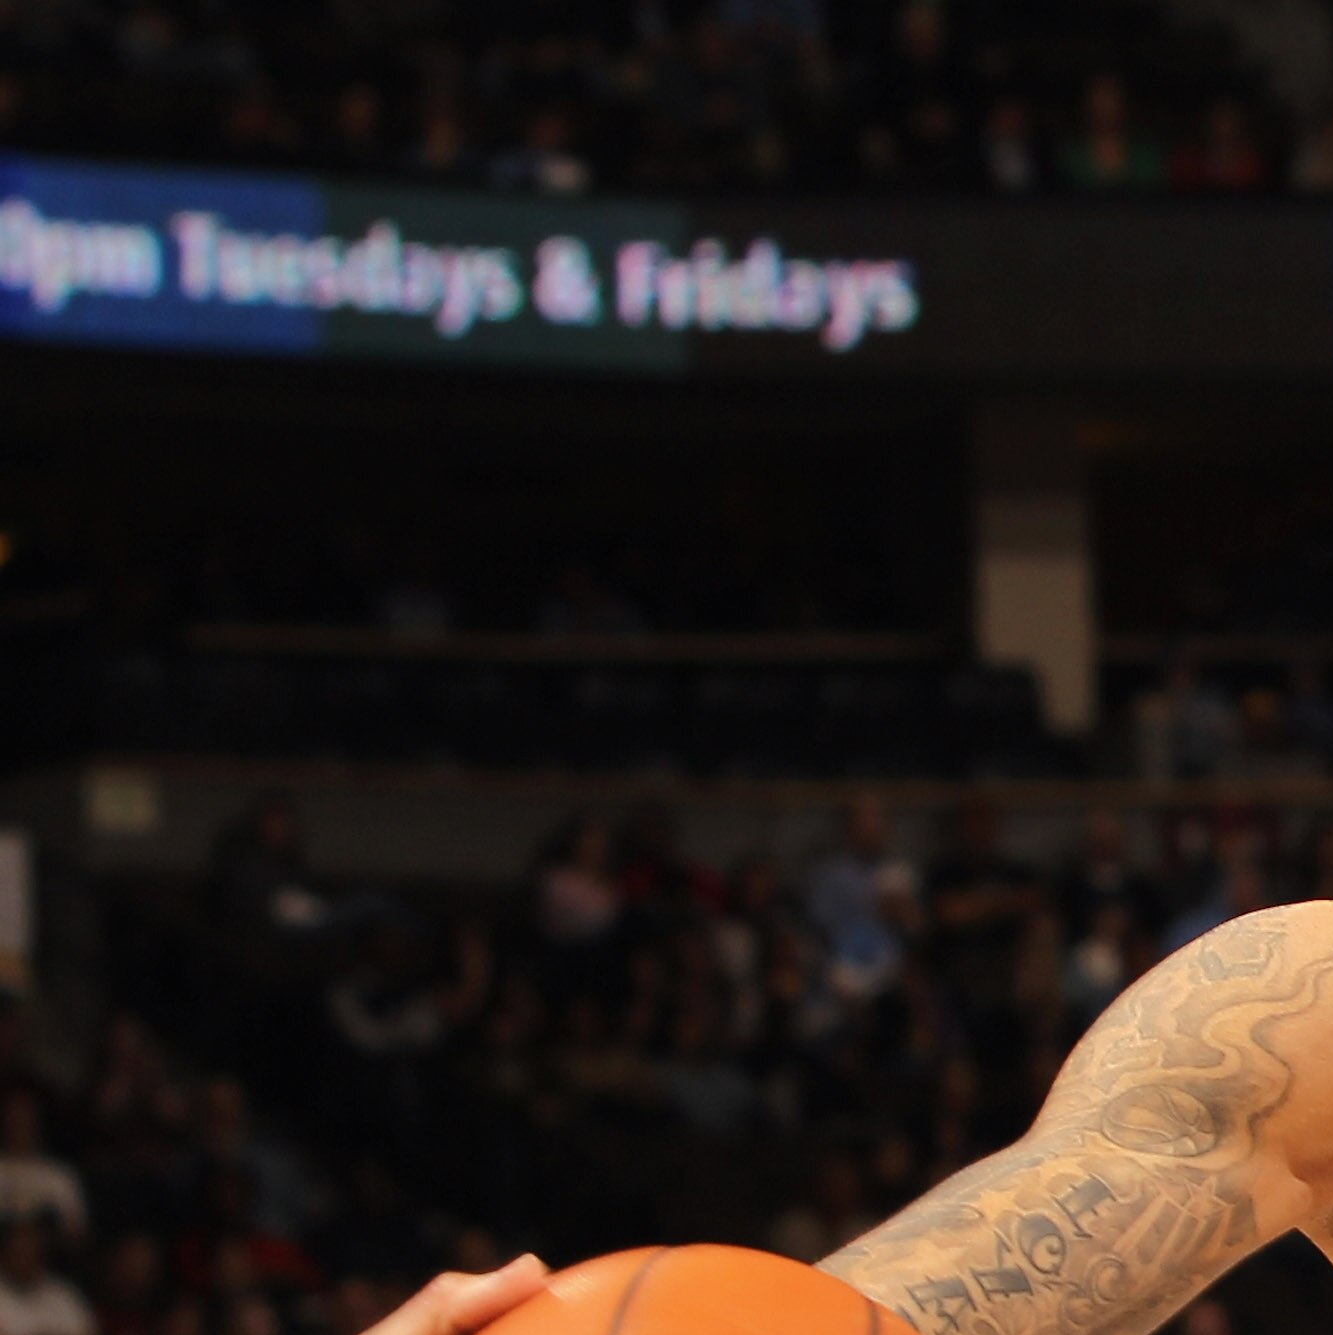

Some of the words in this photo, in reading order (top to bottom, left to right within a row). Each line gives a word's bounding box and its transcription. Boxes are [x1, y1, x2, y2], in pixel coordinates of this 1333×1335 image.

[172, 210, 522, 338] Tuesdays
[534, 236, 600, 326] &
[616, 239, 917, 353] Fridays
